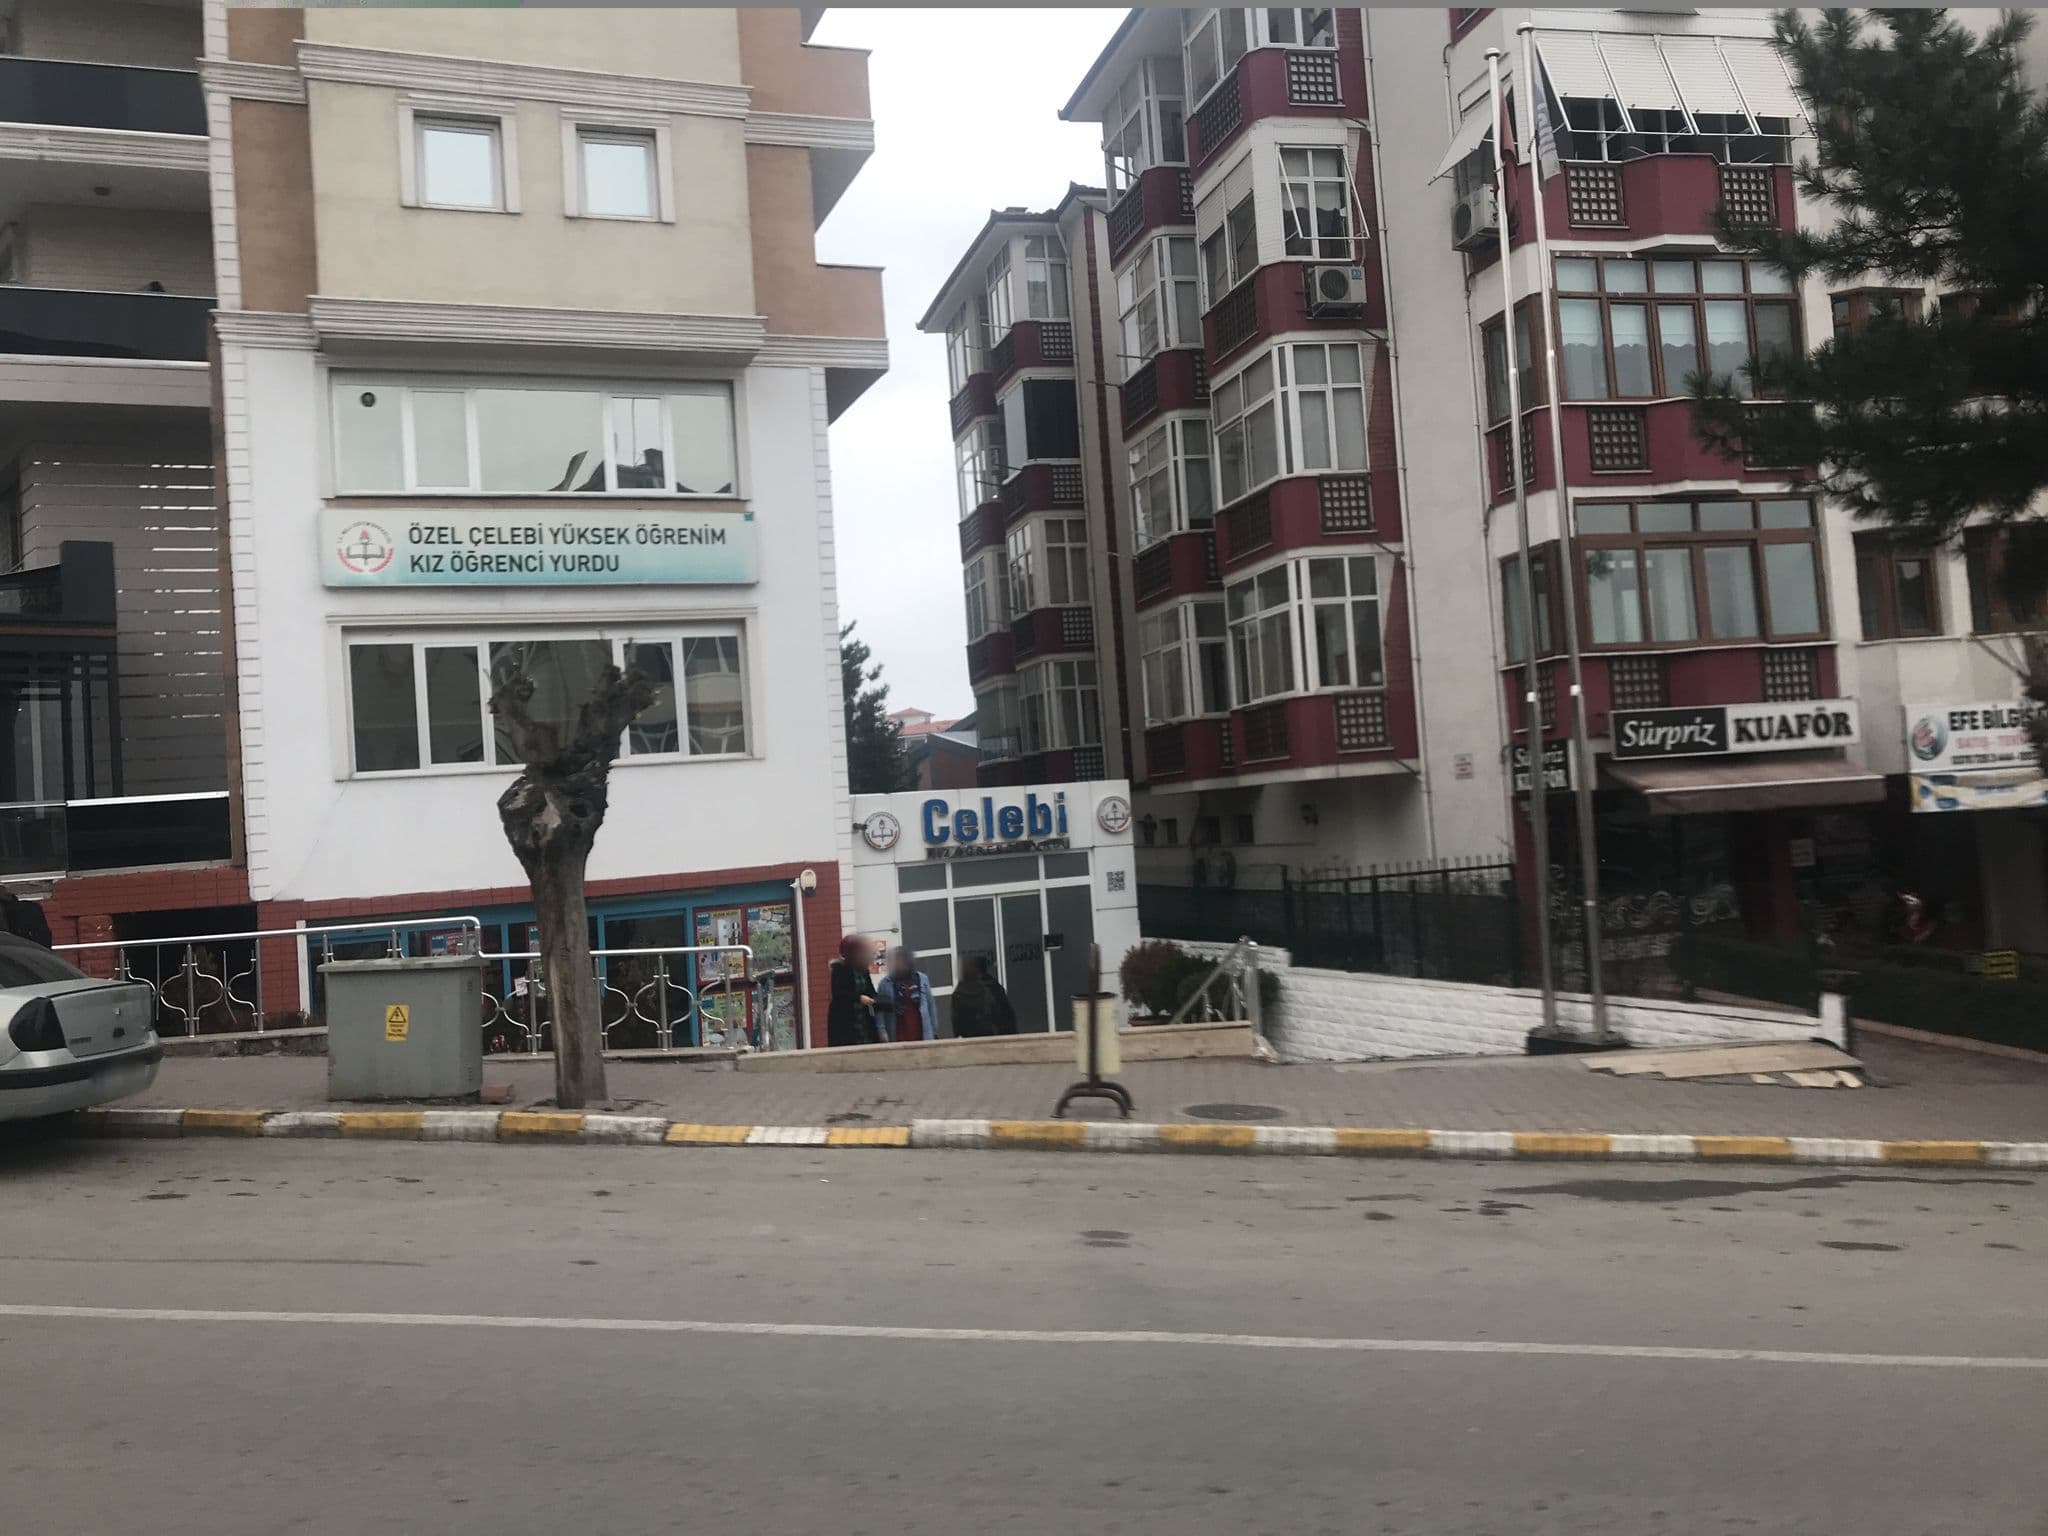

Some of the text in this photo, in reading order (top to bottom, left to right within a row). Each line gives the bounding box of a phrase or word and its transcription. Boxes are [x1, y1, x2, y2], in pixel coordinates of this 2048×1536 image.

[408, 522, 726, 548] ÖZEL ÇELEBİ YÜKSEK ÖĞRENİM
[410, 550, 619, 573] KIZ ÖĞRENCİ YURDU
[1621, 707, 1853, 751] Sürpriz KUAFÖR
[1948, 710, 1980, 731] EFE
[922, 791, 1068, 845] Celebi
